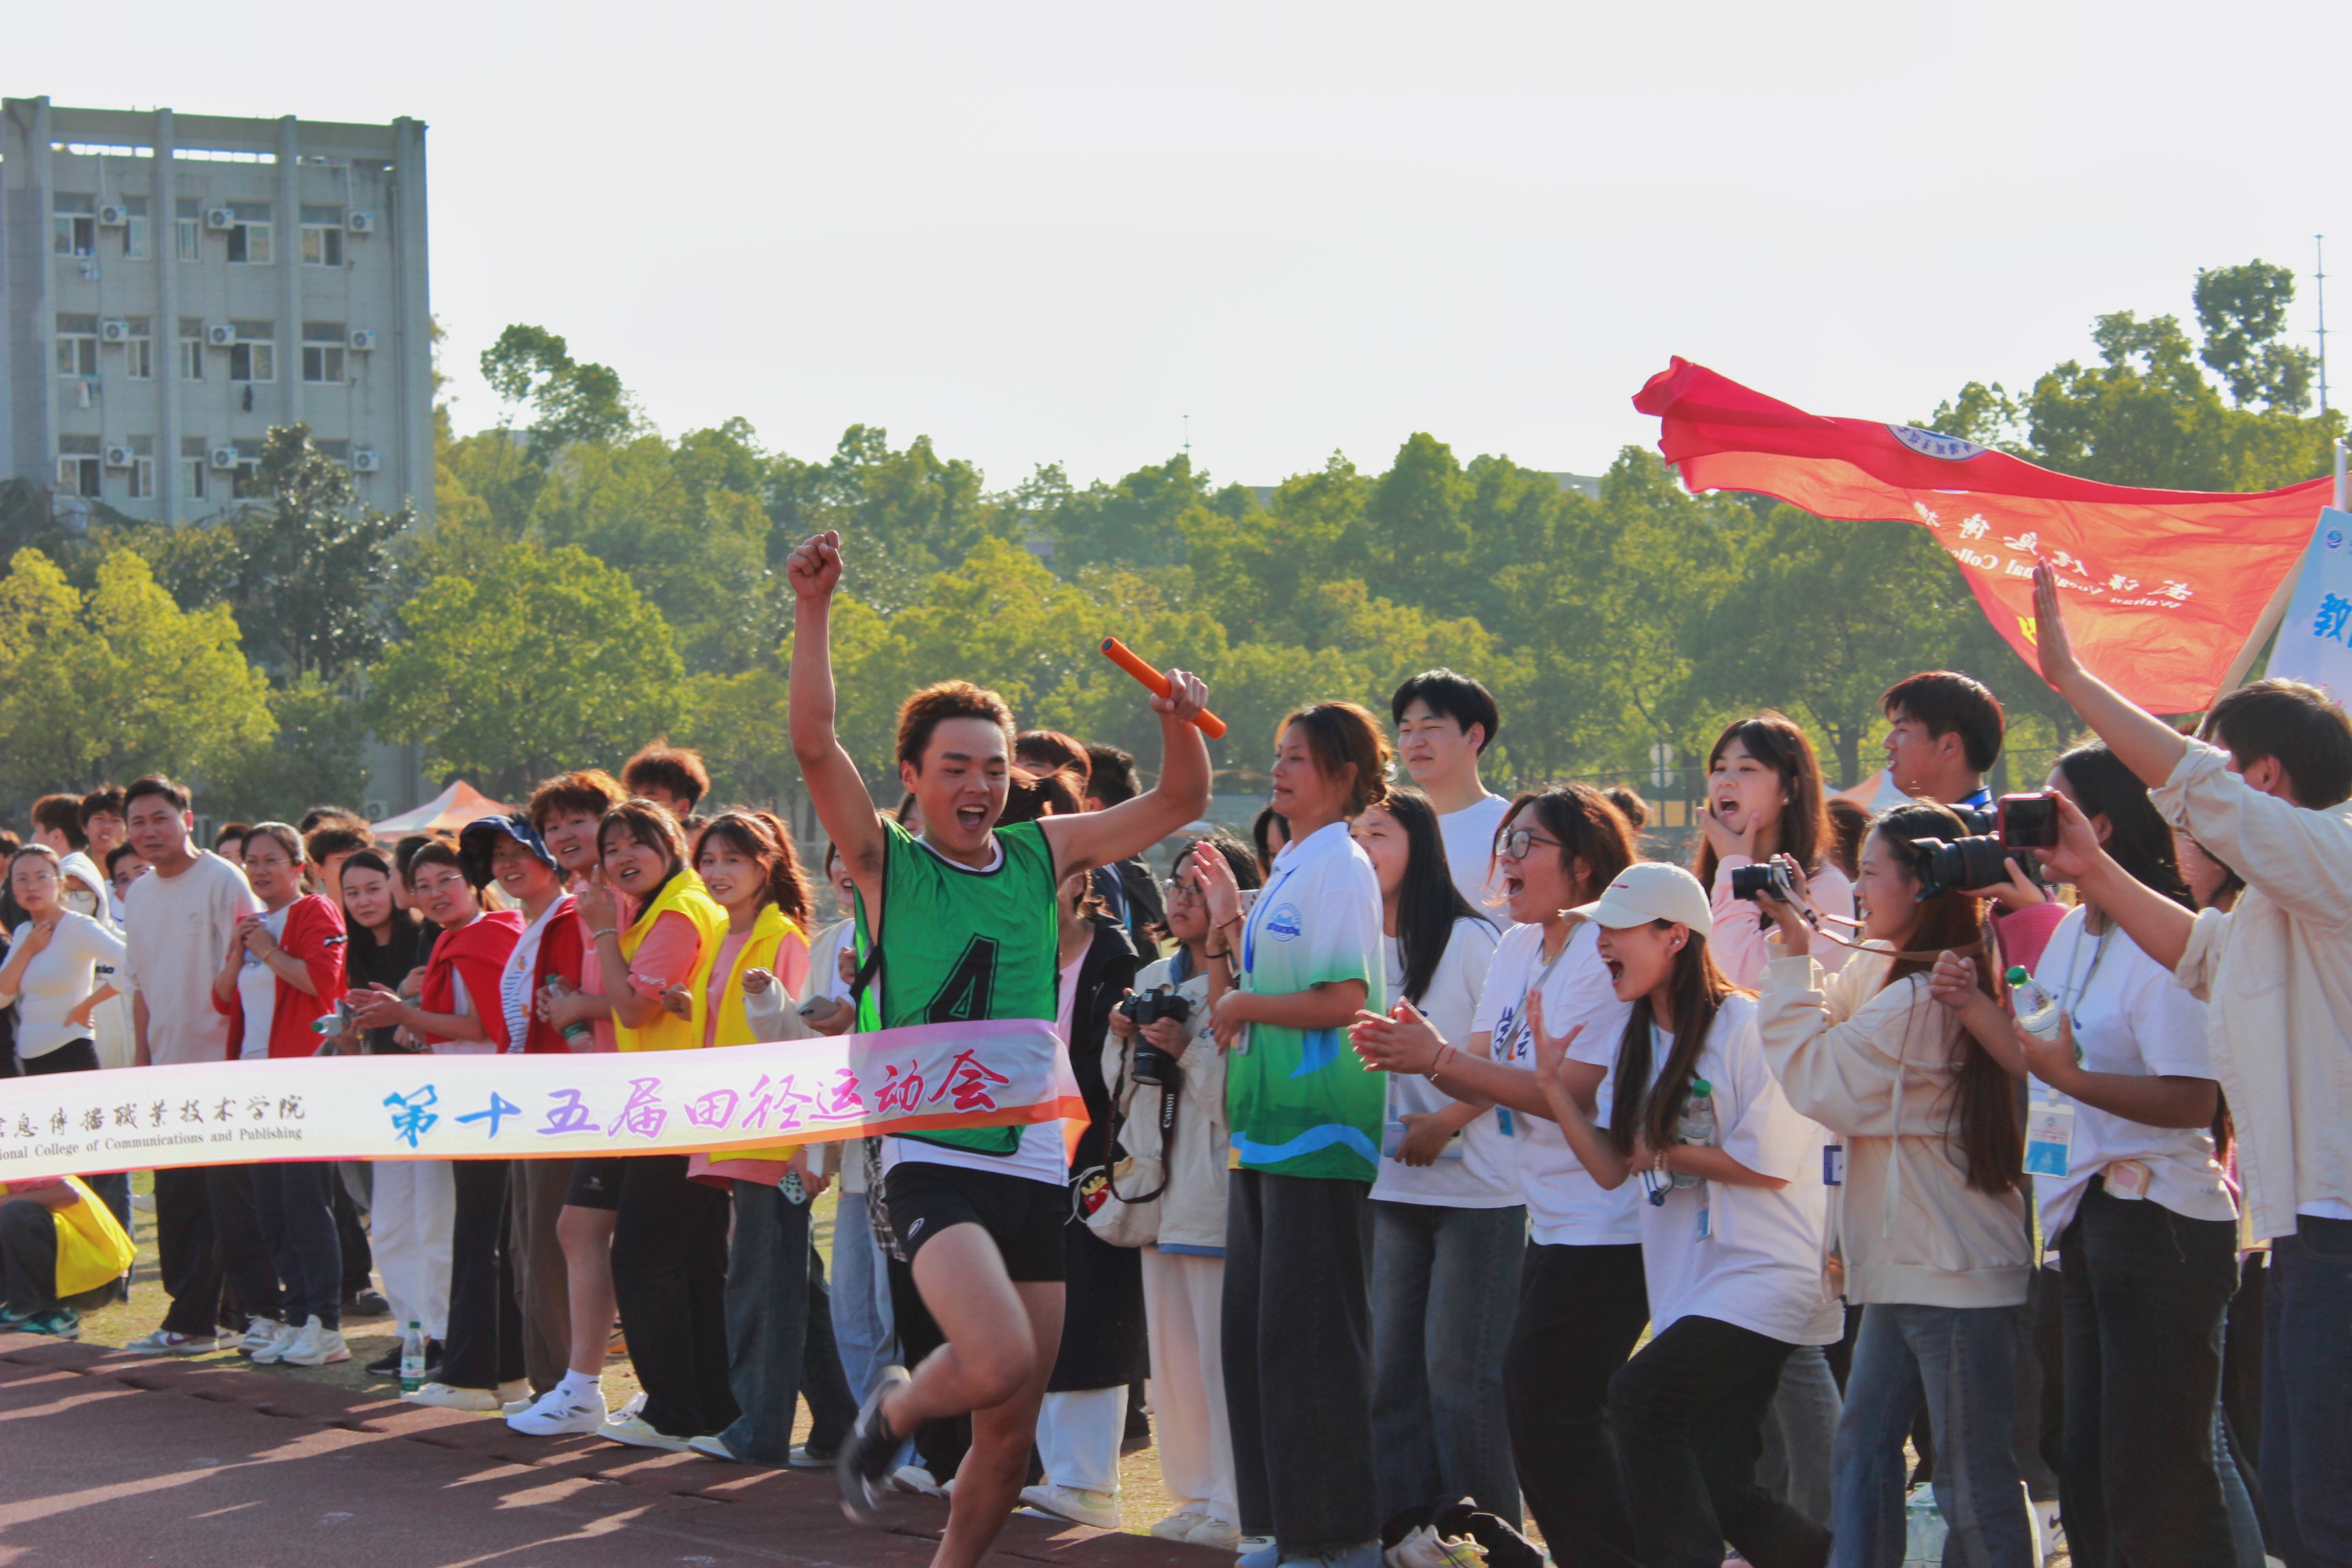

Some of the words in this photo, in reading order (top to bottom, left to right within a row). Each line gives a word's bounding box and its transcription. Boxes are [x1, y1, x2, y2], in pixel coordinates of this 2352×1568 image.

[2314, 593, 2352, 648] 教
[924, 932, 1000, 1024] 4
[382, 1049, 1010, 1148] 第十五届田径运动会
[1162, 1094, 1175, 1128] Canon
[35, 1143, 79, 1156] College
[86, 1139, 99, 1152] of
[105, 1132, 203, 1150] Communications
[210, 1130, 233, 1143] and
[240, 1126, 302, 1141] Publishing
